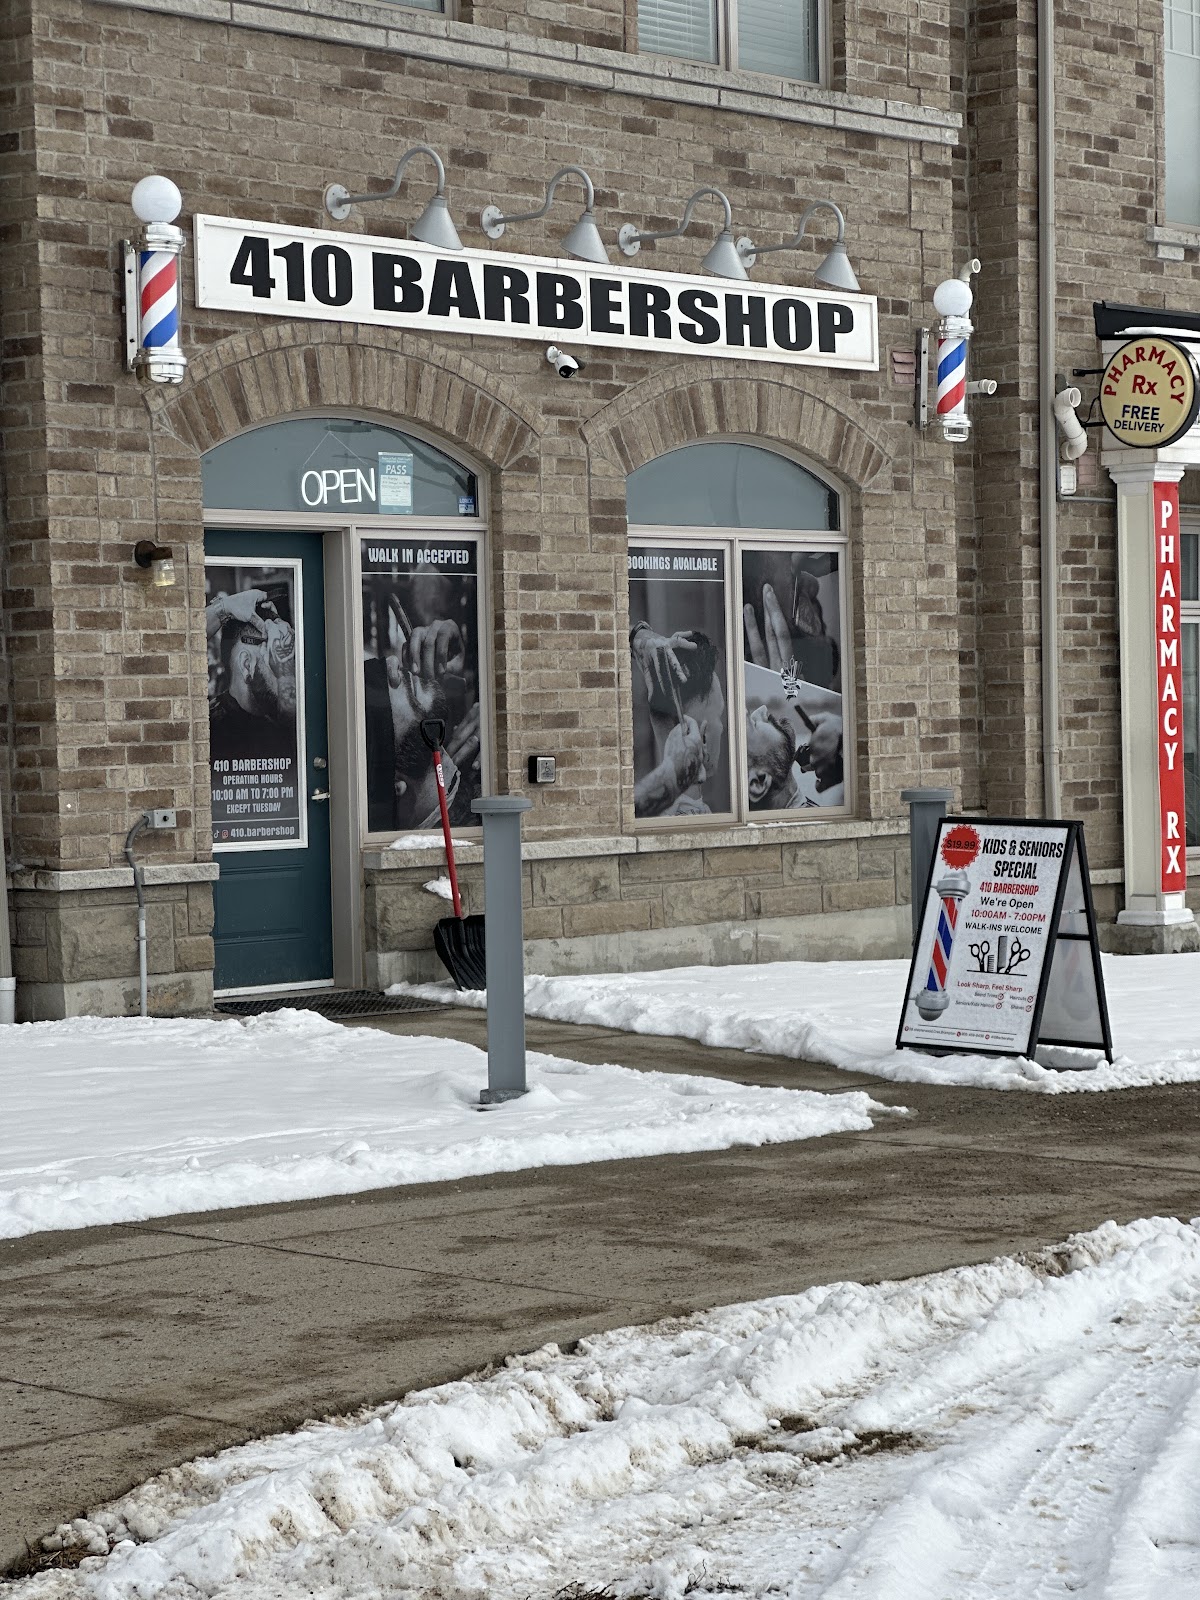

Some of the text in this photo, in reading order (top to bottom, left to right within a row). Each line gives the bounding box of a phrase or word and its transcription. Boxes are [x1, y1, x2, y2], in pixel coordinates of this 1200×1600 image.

[229, 236, 854, 353] 410 BARBERSHOP
[1103, 346, 1185, 405] PHARMACY
[1132, 374, 1158, 395] Rx
[1121, 404, 1160, 421] FREE
[1114, 419, 1165, 433] DELIVERY
[385, 464, 407, 475] PASS
[301, 467, 376, 506] OPEN
[368, 547, 470, 565] WALK IN ACCEPTED
[628, 555, 718, 571] BOOKINGS AVAILABLE
[1159, 500, 1181, 874] PHARMACY RX
[213, 758, 292, 772] 410 BARBERSHOP
[223, 773, 283, 785] OPERATING HOURS
[212, 786, 294, 801] 10:00 AM TO 7:00 PM
[226, 802, 281, 814] EXCEPT TUESDAY
[230, 826, 295, 838] 410.barbershop
[946, 839, 976, 850] $19.99
[982, 838, 1064, 858] KIDS & SENIORS
[993, 860, 1038, 879] SPECIAL
[979, 881, 1040, 896] 410 BARBERSHOP
[980, 896, 1034, 909] We're Open
[971, 909, 1007, 920] 10:00AM
[1014, 912, 1046, 922] 7:00PM
[965, 922, 1043, 935] WALK-INS WELCOME
